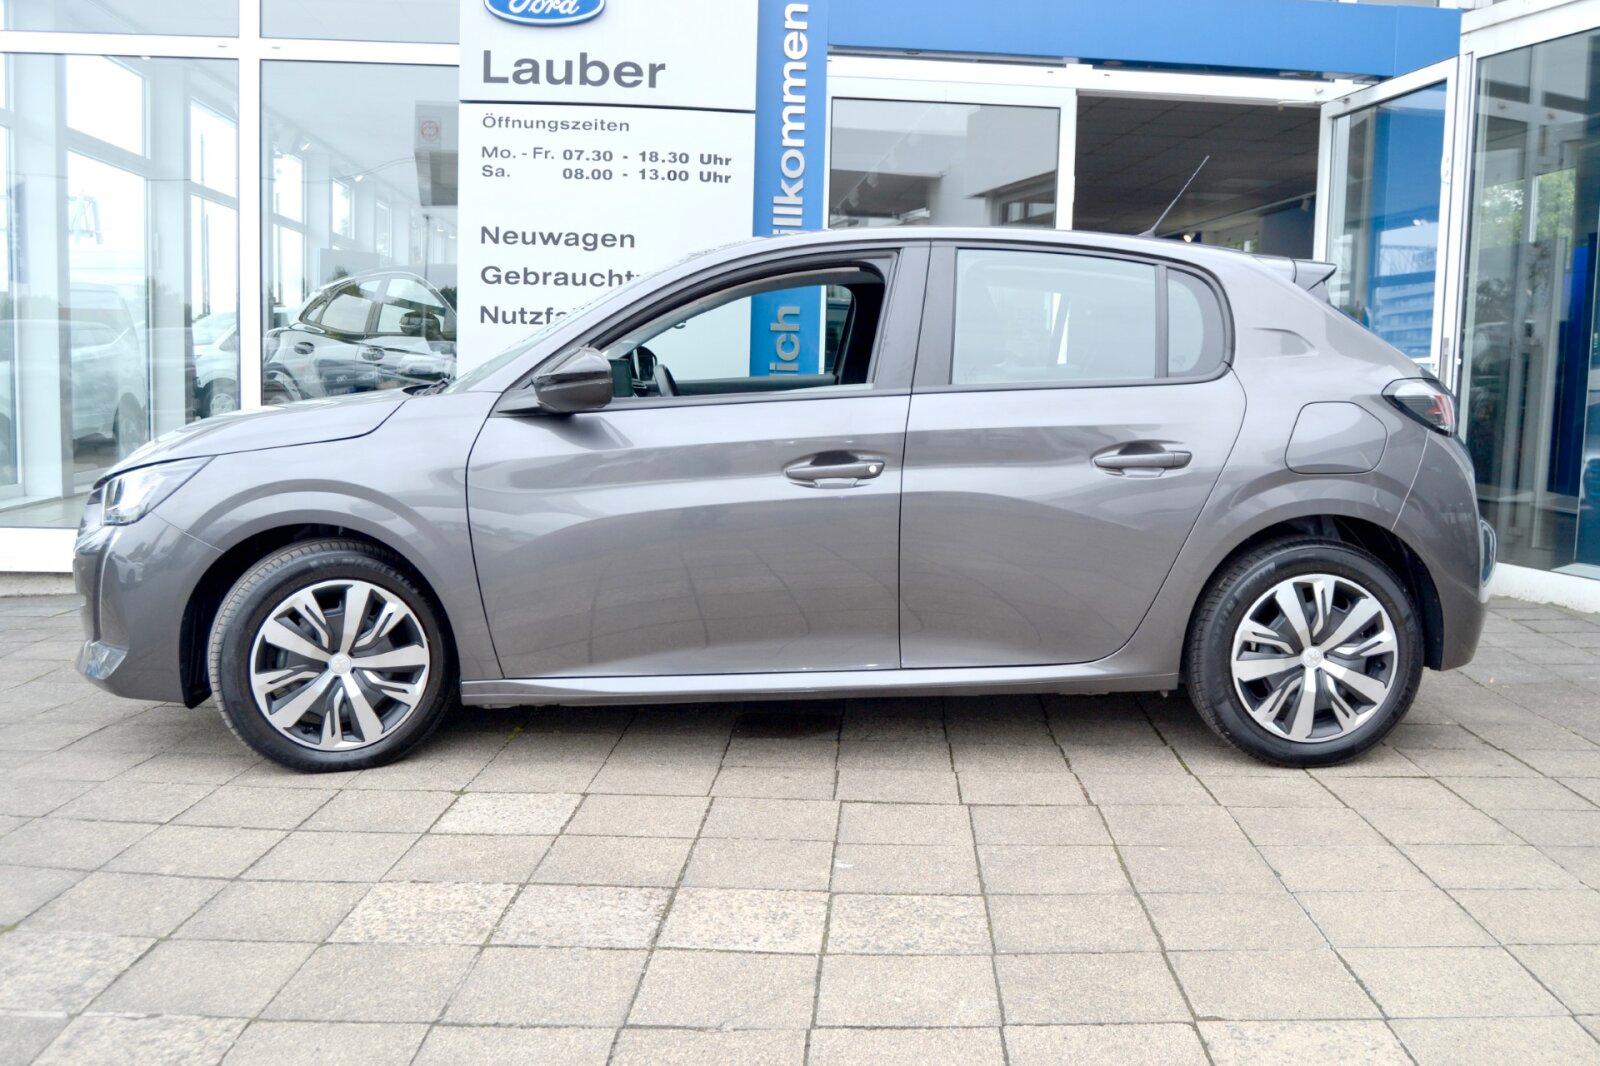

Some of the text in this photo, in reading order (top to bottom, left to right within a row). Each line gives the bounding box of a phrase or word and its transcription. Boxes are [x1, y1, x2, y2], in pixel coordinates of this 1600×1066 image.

[483, 50, 666, 88] Lauber
[482, 112, 630, 132] Öffnungszeiten
[481, 146, 516, 159] Mo.
[532, 147, 555, 160] Fr.
[562, 149, 613, 162] 07.30
[639, 151, 690, 164] 18.30
[699, 153, 732, 166] Uhr
[481, 164, 510, 178] Sa.
[562, 168, 613, 180] 08.00
[639, 168, 690, 182] 13.00
[699, 170, 732, 184] Uhr
[480, 226, 635, 251] Neuwagen
[480, 265, 640, 288] Gebraucht
[480, 305, 567, 325] Nutzf
[769, 306, 801, 376] ich
